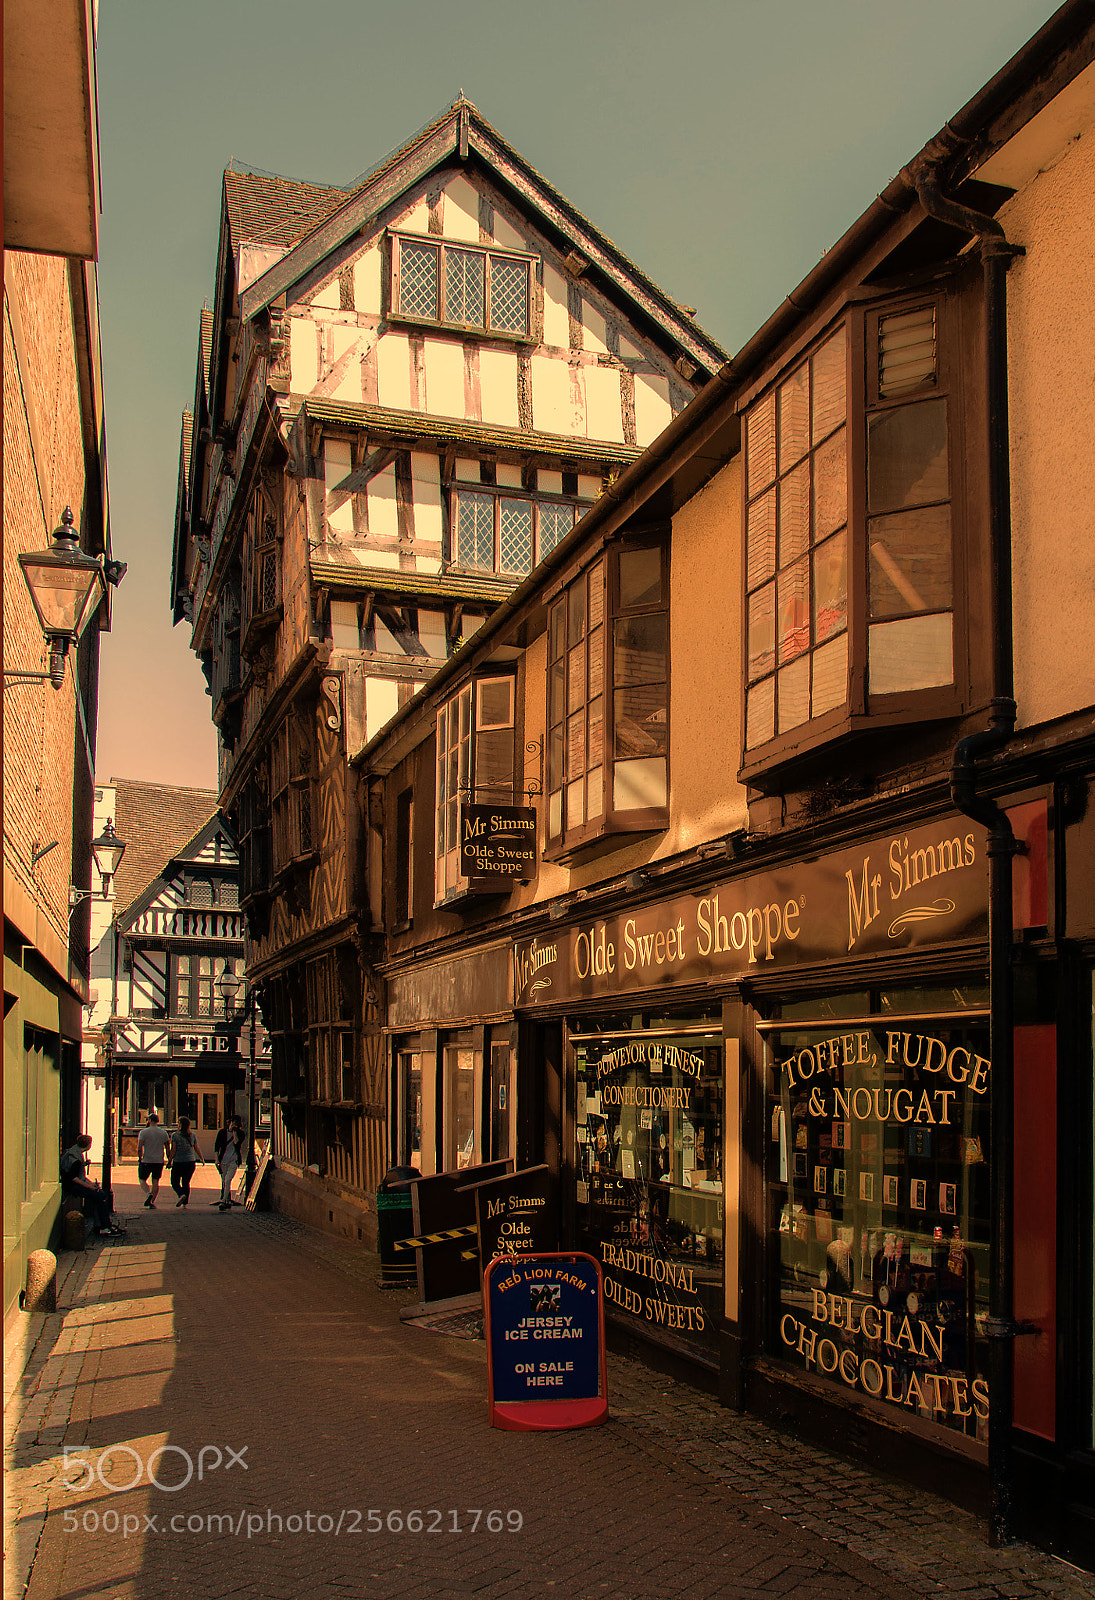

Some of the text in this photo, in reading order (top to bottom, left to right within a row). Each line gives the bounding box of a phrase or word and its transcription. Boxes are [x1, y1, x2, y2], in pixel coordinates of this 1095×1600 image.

[464, 815, 535, 841] Mr Simms
[464, 845, 534, 859] Olde Sweet
[476, 858, 522, 874] Shoppe
[845, 832, 976, 951] Mr Simms
[530, 938, 558, 976] Simms
[574, 925, 615, 979] Olde
[624, 917, 686, 970] Sweet
[180, 1035, 229, 1053] THE
[596, 1042, 705, 1081] PURVEYOR OF FINEST
[781, 1030, 992, 1095] TOFFEE, FUDGE
[604, 1085, 691, 1109] CONFECTIONERY
[808, 1086, 956, 1125] & NOUGAT
[487, 1195, 546, 1219] Mr Simms
[500, 1222, 531, 1235] Olde
[496, 1237, 534, 1250] Sweet
[600, 1241, 698, 1294] TRADITIONAL
[498, 1268, 587, 1293] RED LION FARM
[603, 1277, 705, 1331] OILED SWEETS
[505, 1328, 583, 1341] ICE CREAM
[518, 1316, 573, 1328] JERSEY
[811, 1288, 945, 1362] BELGIAN
[515, 1361, 574, 1374] ON SALE
[779, 1313, 990, 1419] CHOCOLATES
[526, 1375, 564, 1387] HERE
